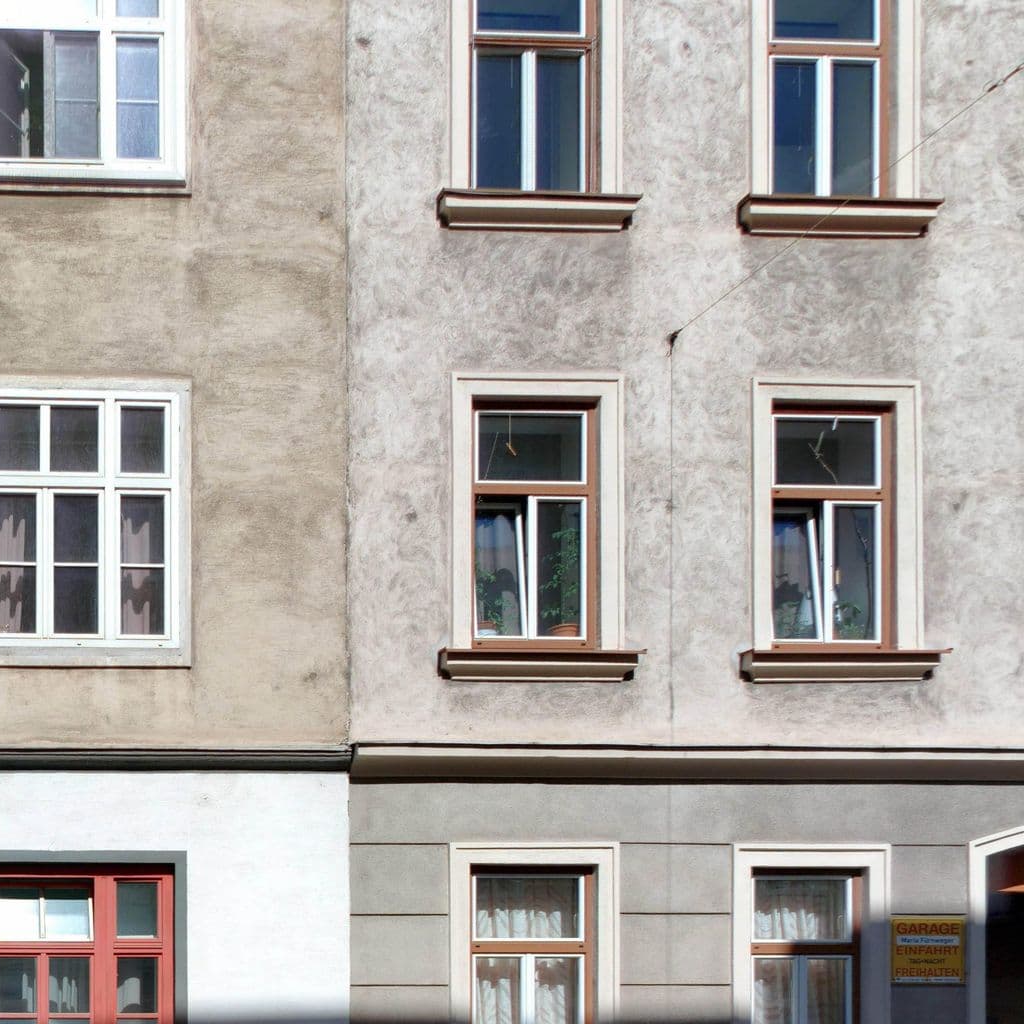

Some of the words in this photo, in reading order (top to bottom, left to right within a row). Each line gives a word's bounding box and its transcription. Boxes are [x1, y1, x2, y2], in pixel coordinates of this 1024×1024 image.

[896, 922, 960, 935] GARAGE
[896, 946, 960, 955] EINFAHRT
[895, 968, 960, 977] FREIHALTEN
